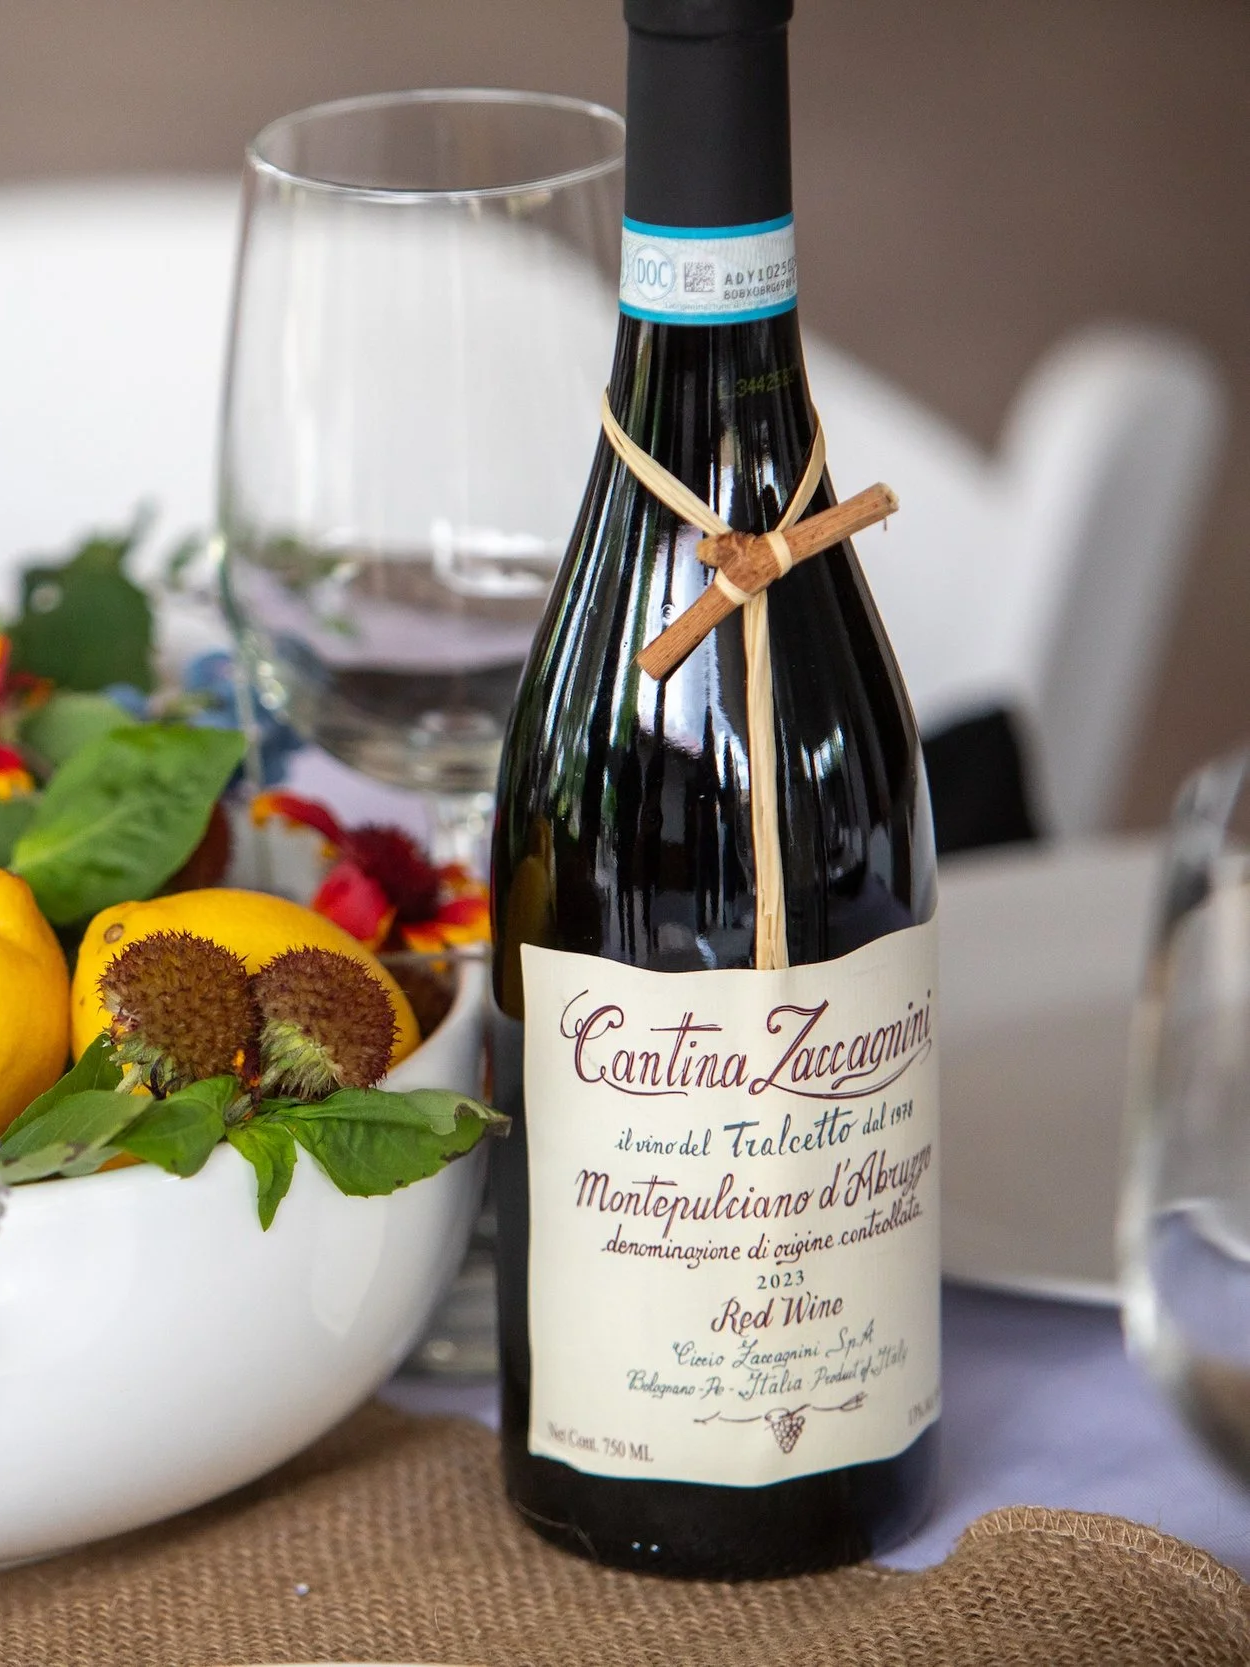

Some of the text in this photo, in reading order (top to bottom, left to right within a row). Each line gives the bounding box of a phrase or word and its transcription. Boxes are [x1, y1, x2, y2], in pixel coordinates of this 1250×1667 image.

[638, 258, 669, 288] DOC
[560, 989, 932, 1099] Cantina Zaccagnini
[635, 1135, 678, 1155] vino
[679, 1129, 711, 1157] del
[723, 1106, 858, 1159] Tralcetto
[862, 1101, 886, 1135] dal
[890, 1099, 914, 1126] 1978
[575, 1143, 932, 1239] Montepulciano d'Abruzzo
[602, 1195, 923, 1269] denominazione di origine controllata
[756, 1269, 806, 1292] 2023
[710, 1291, 845, 1336] Red Wine
[732, 1336, 821, 1371] Zaccagnini
[626, 1369, 696, 1399] Bolognano
[738, 1368, 802, 1401] Italia
[810, 1362, 859, 1392] Product
[602, 1436, 627, 1458] 750
